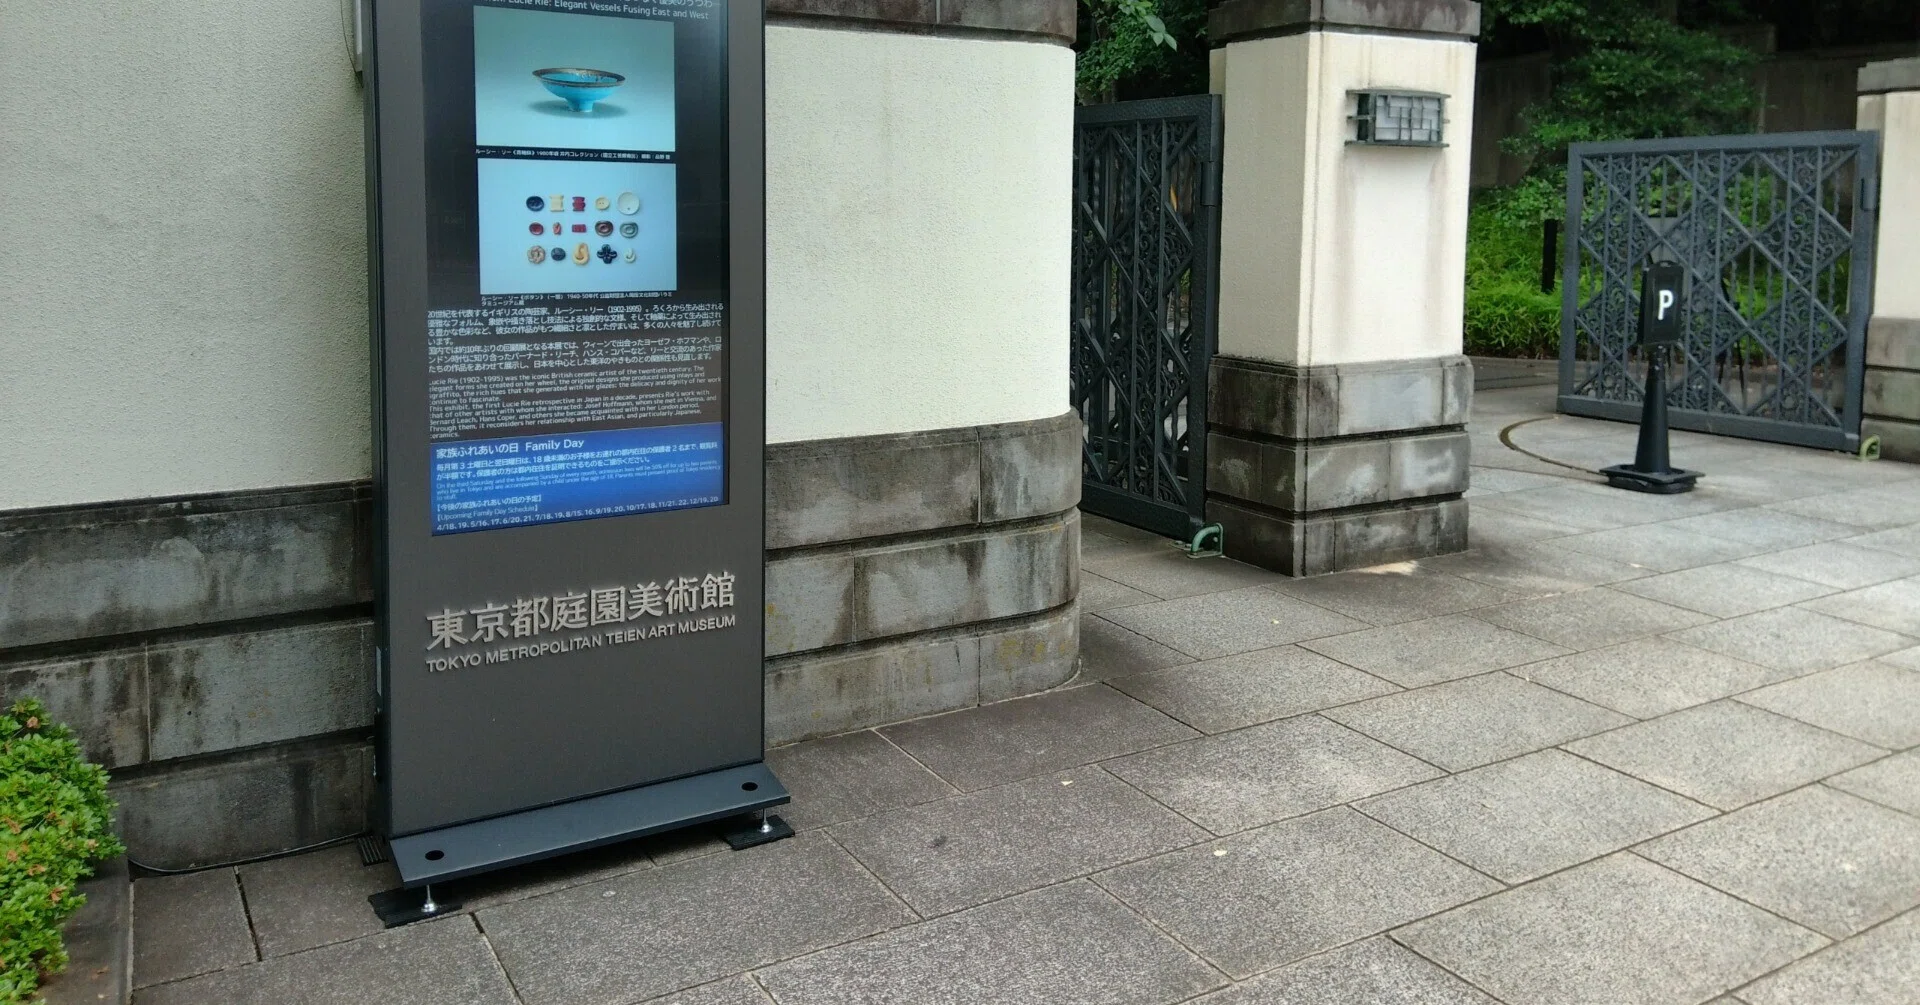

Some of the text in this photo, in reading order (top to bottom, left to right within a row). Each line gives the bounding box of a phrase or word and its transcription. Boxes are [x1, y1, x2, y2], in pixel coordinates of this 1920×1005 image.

[554, 0, 588, 10] Elegant
[590, 3, 621, 12] Vessels
[623, 5, 650, 16] Fusing
[652, 7, 670, 16] East
[689, 11, 709, 19] West
[1658, 290, 1673, 320] P
[632, 373, 659, 382] produced
[535, 385, 568, 394] generated
[532, 397, 576, 405] retrospective
[639, 392, 664, 400] presents
[537, 416, 575, 424] relationship
[639, 410, 673, 419] particularly
[590, 406, 623, 415] acquainted
[436, 439, 584, 458] 家族ふれあいの日 Family Day
[426, 571, 736, 650] 東京都庭園美術館
[426, 614, 736, 672] TOKYO METROPOLITAN TEIEN ART MUSEUM
